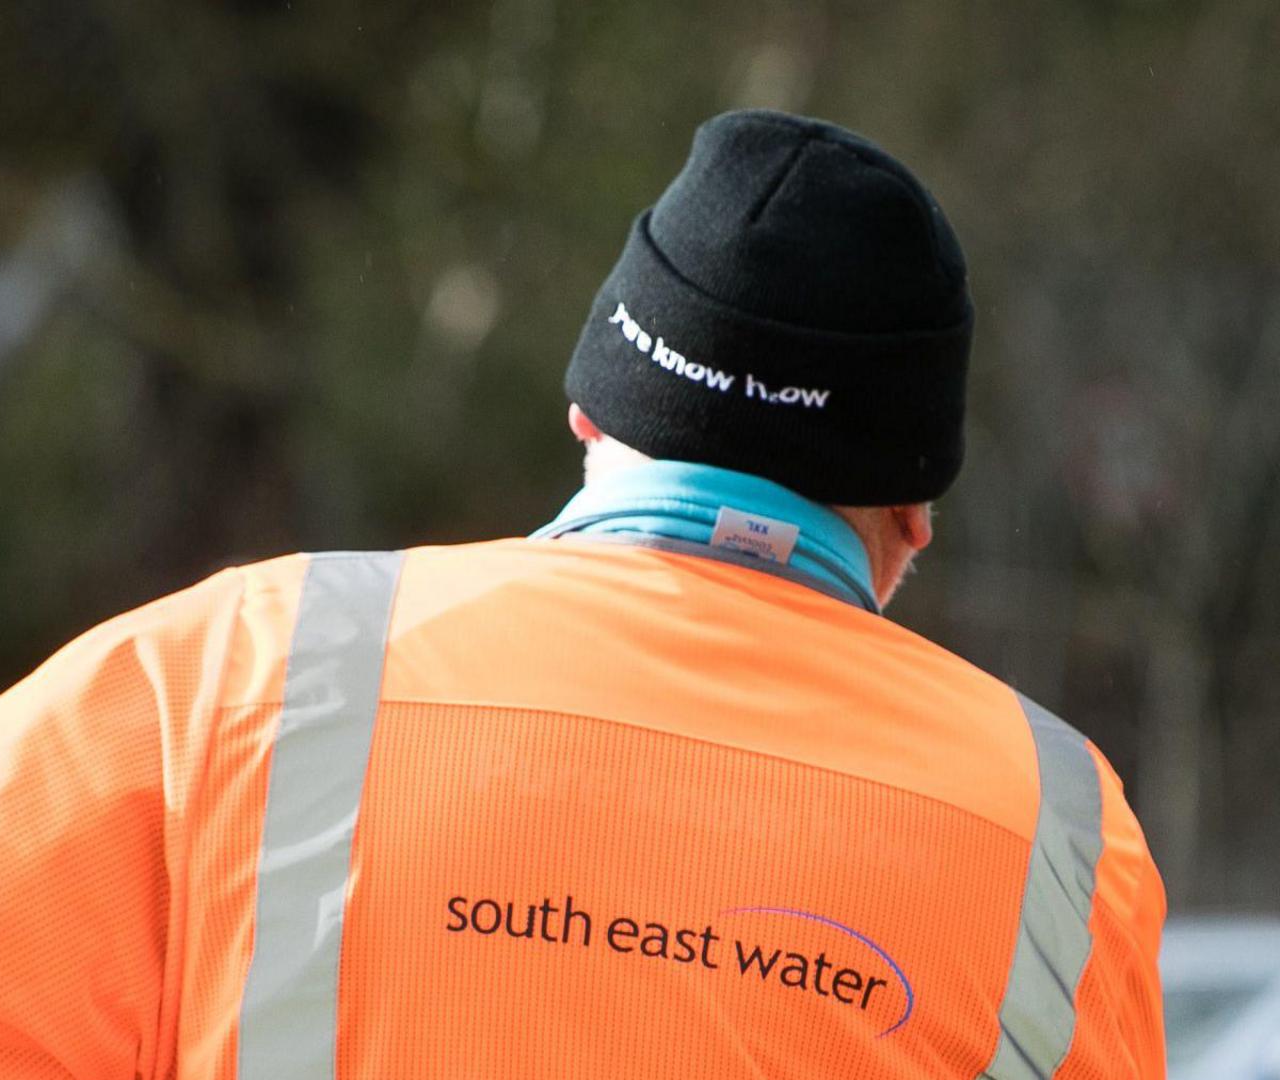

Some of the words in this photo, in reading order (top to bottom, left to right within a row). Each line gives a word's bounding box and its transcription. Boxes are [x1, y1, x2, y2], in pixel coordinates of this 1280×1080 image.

[651, 336, 735, 392] know
[446, 896, 592, 947] south
[607, 917, 720, 969] east
[735, 939, 888, 1010] water
